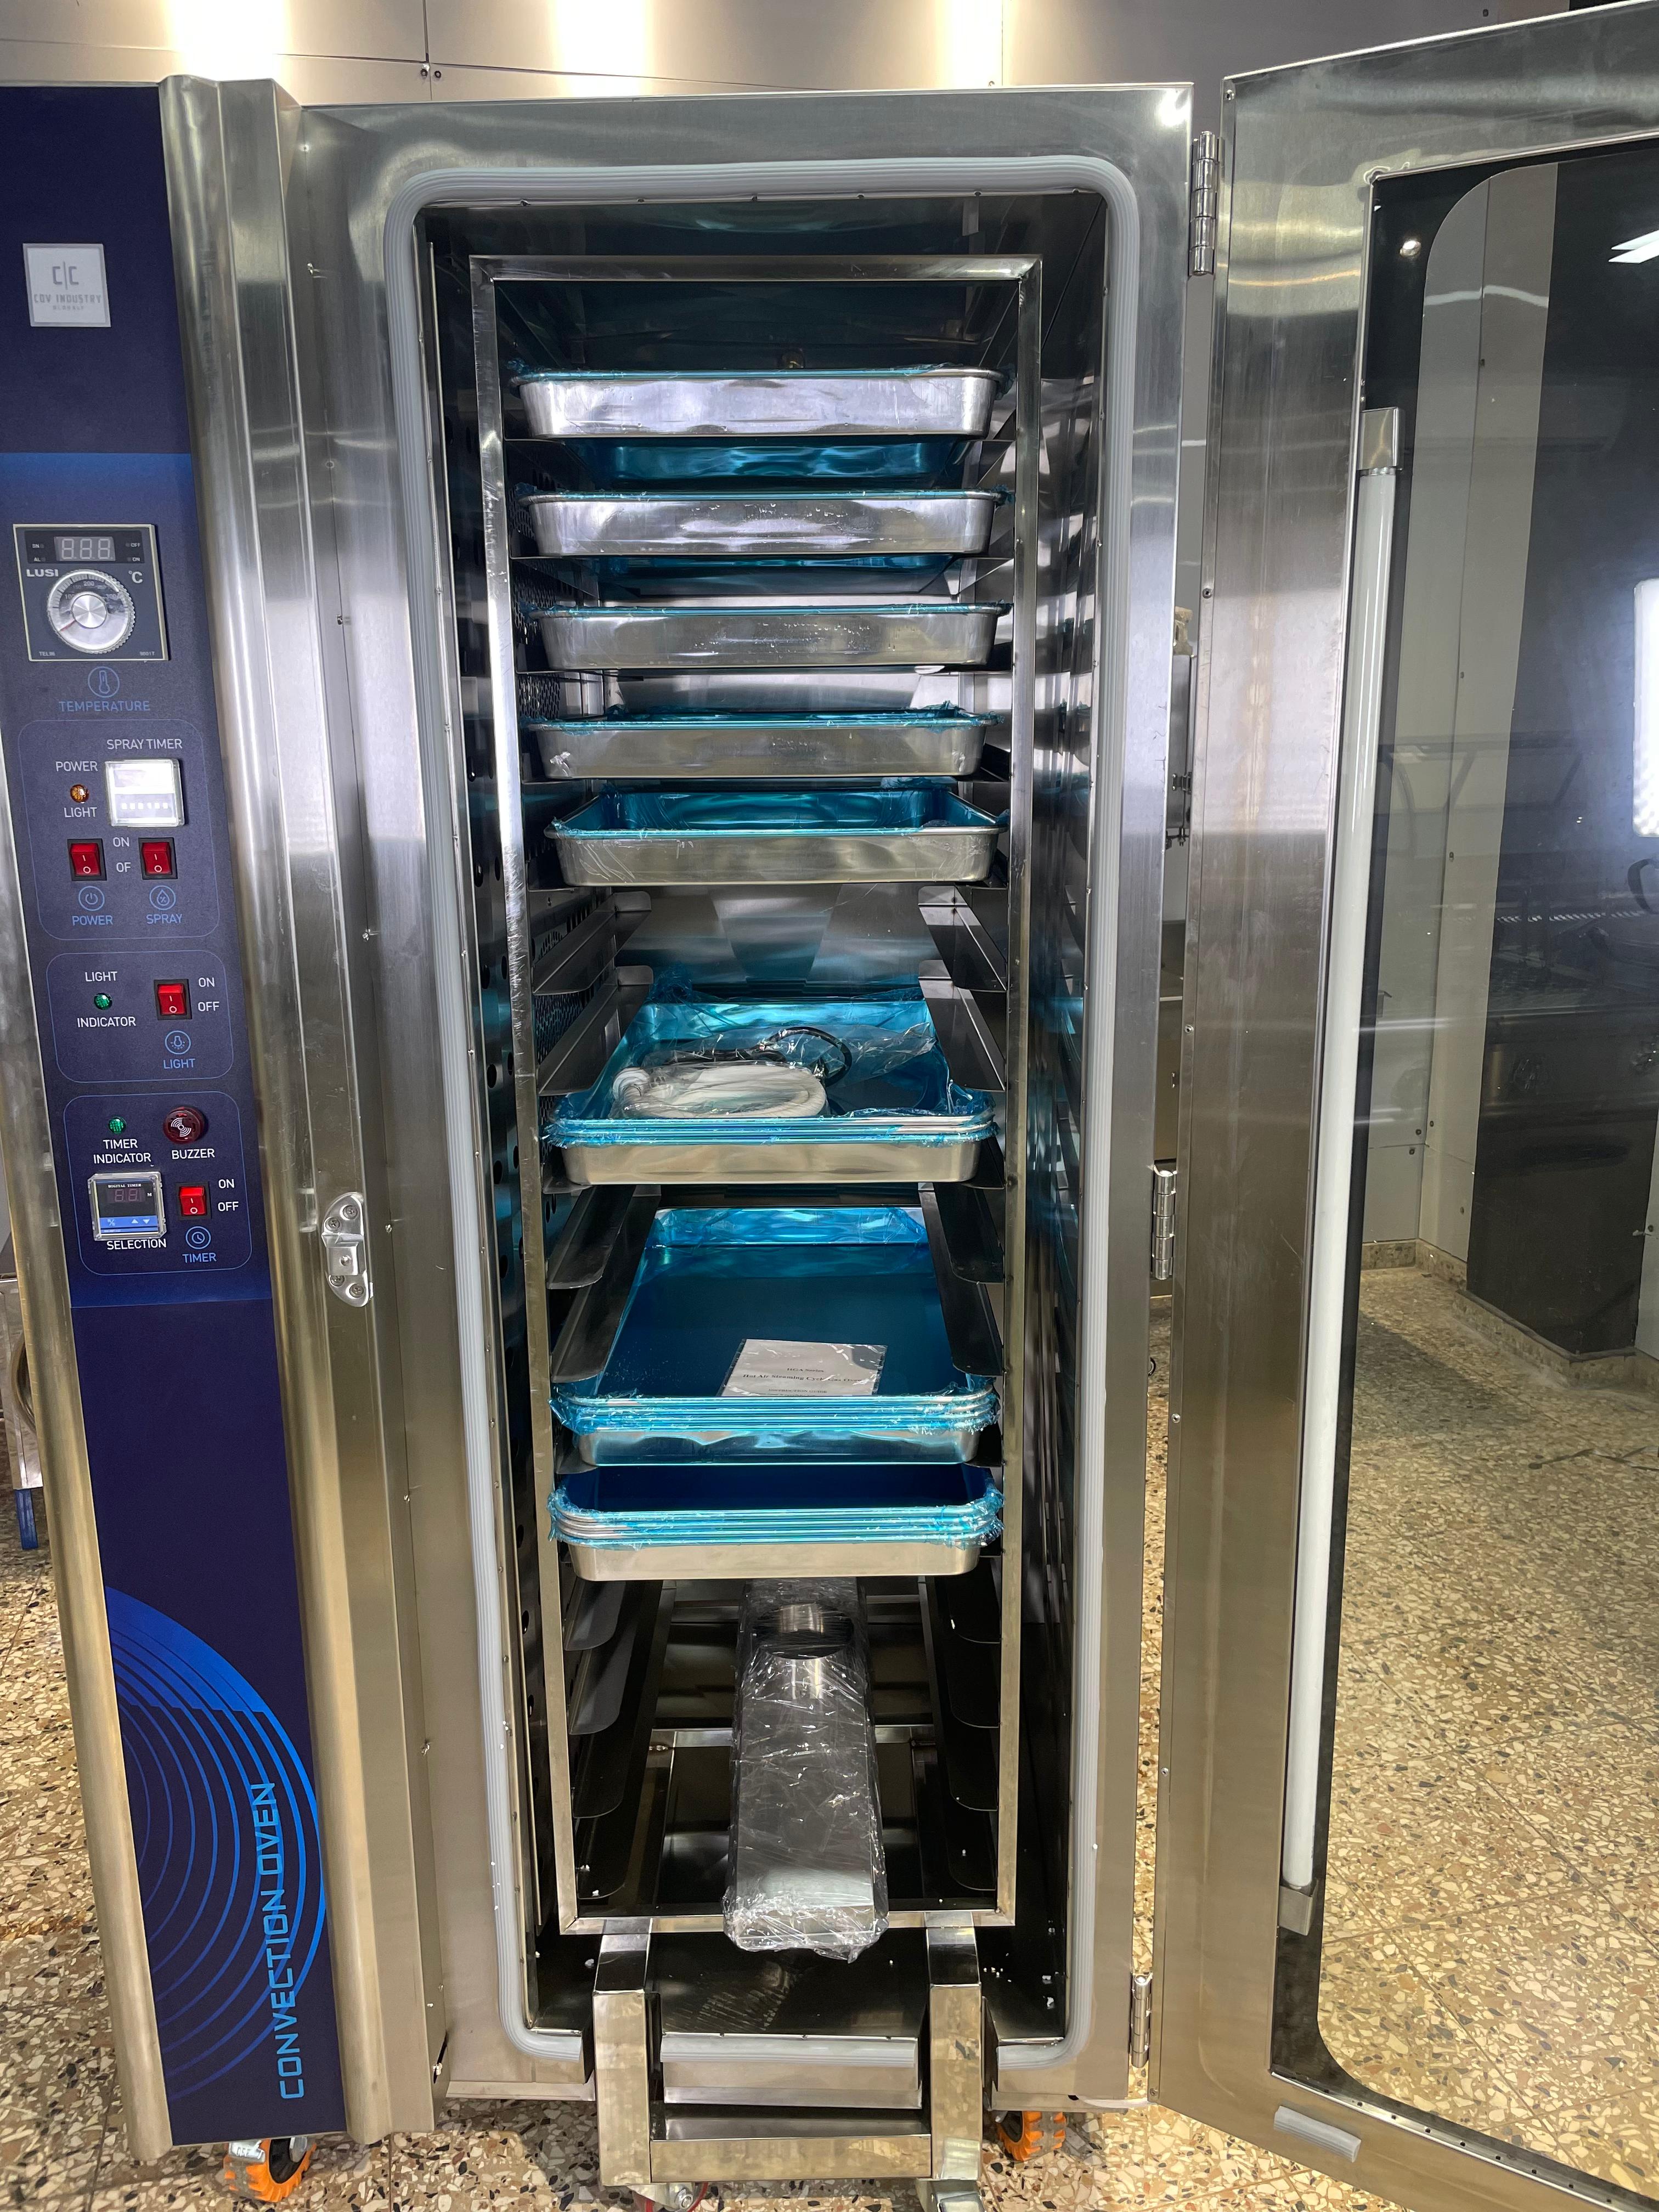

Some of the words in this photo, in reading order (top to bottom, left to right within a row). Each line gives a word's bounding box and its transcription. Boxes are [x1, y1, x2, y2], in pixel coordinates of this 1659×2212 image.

[56, 294, 101, 303] INDUSTRY
[26, 568, 59, 577] LUSI
[59, 701, 151, 712] TEMPERATURE
[106, 739, 144, 750] SPRAY
[146, 738, 183, 749] TIMER
[55, 761, 98, 772] POWER
[64, 807, 97, 818] LIGHT
[112, 837, 129, 847] ON
[116, 862, 131, 872] OF
[72, 915, 114, 926] POWER
[146, 913, 183, 924] SPRAY
[84, 971, 118, 982] LIGHT
[198, 977, 215, 988] ON
[198, 1001, 220, 1012] OFF
[77, 1016, 136, 1028] INDICATOR
[163, 1058, 196, 1069] LIGHT
[103, 1139, 138, 1149] TIMER
[93, 1153, 151, 1164] INDICATOR
[171, 1148, 215, 1160] BUZZER
[218, 1179, 235, 1189] ON
[218, 1201, 239, 1211] OFF
[106, 1239, 167, 1250] SELECTION
[182, 1252, 217, 1263] TIMER
[250, 1782, 283, 1876] OVEN
[261, 1889, 305, 2100] CONVECTION
